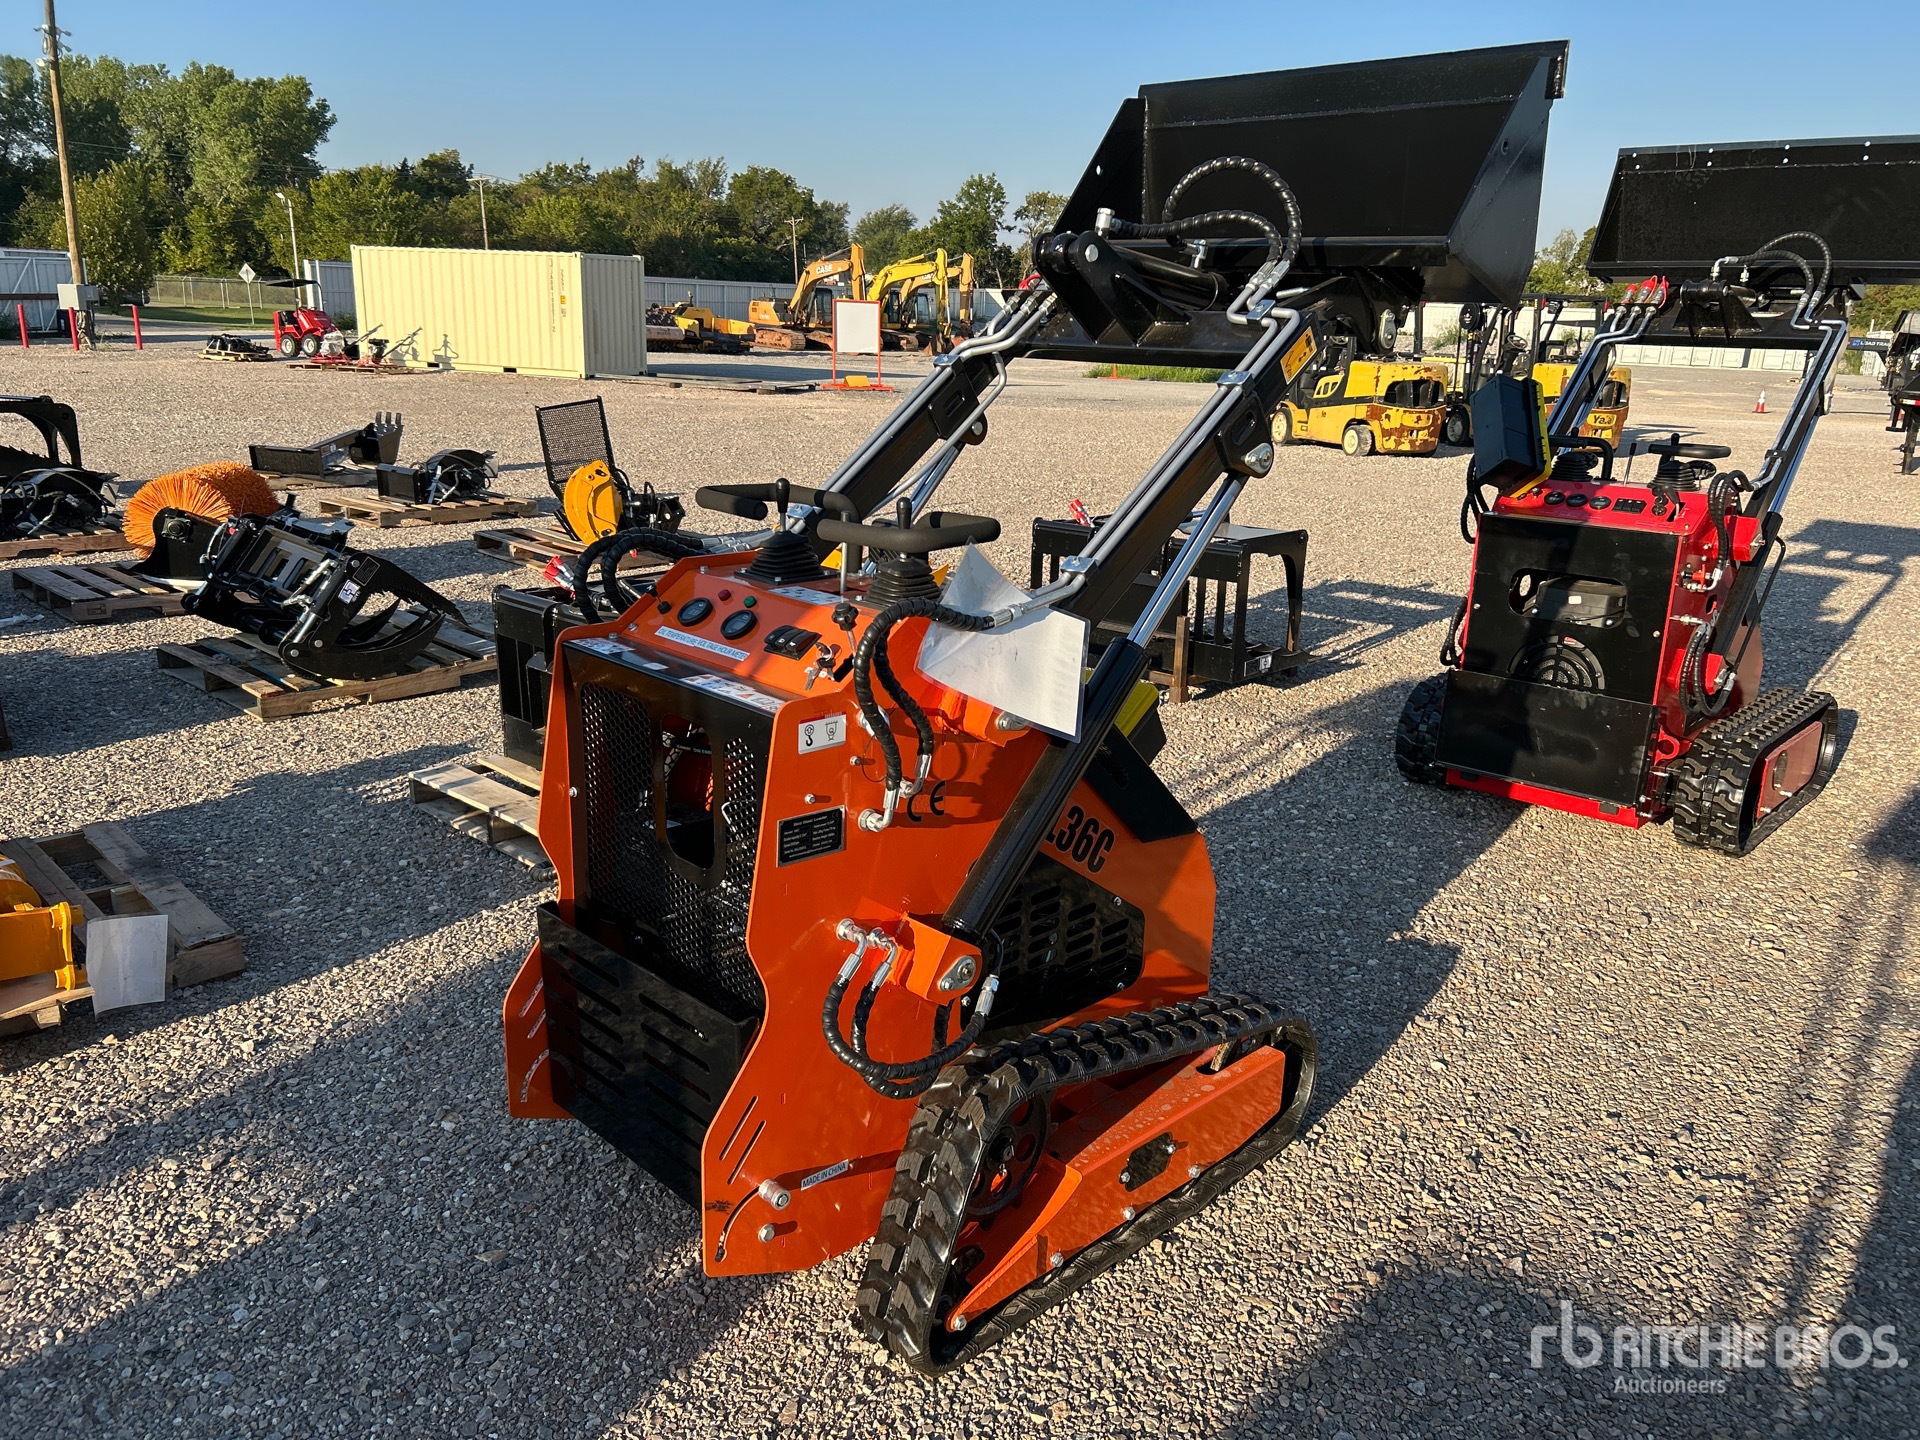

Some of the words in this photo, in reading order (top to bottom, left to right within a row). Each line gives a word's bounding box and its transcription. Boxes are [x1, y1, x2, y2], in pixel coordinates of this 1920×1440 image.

[816, 264, 833, 275] CASE
[666, 629, 698, 645] TEMPERATURE
[698, 637, 720, 651] VOLTAGE
[719, 644, 733, 655] HOUR
[803, 1174, 820, 1188] MADE
[820, 1170, 828, 1179] IN
[828, 1162, 846, 1176] CHINA
